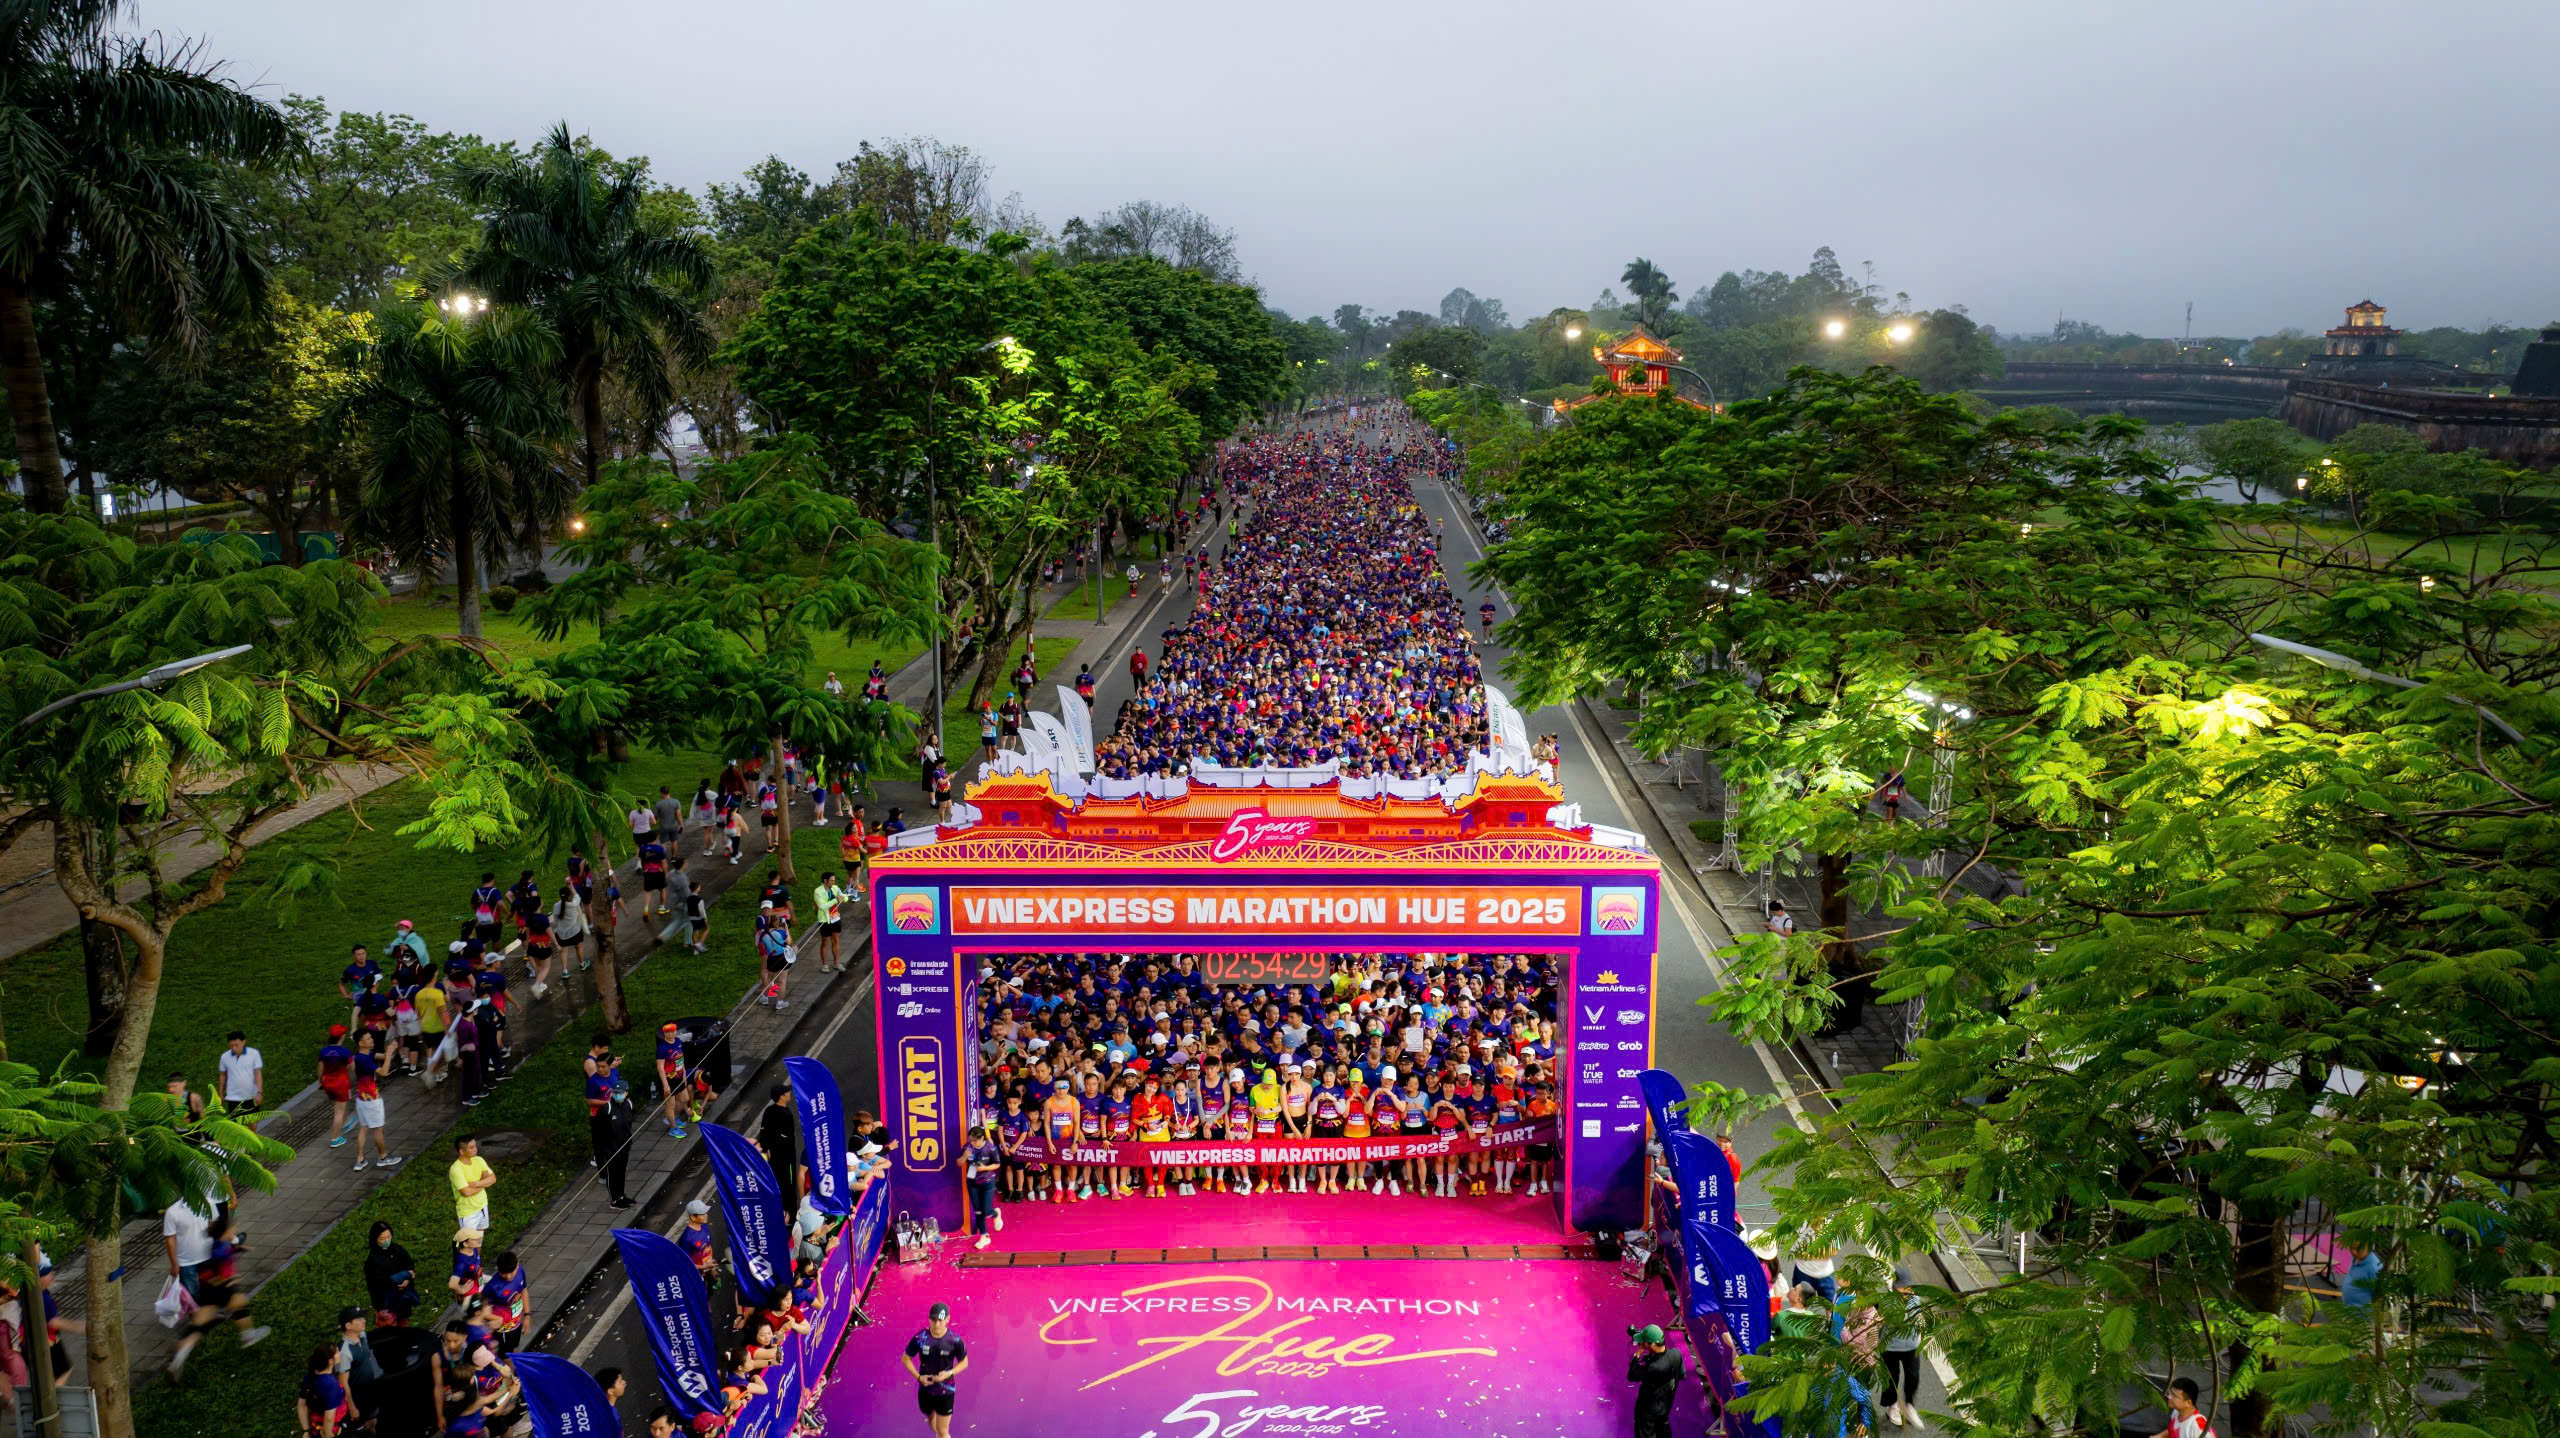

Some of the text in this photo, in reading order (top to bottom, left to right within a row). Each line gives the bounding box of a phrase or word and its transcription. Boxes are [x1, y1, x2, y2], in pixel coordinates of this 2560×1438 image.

[1214, 813, 1310, 858] 5 years
[963, 898, 1566, 924] VNEXPRESS MARATHON HUE 2025
[1206, 952, 1327, 979] 02:54:29
[897, 1001, 923, 1018] FPT
[1617, 1041, 1643, 1051] Grab
[1583, 1071, 1603, 1079] true
[905, 1047, 939, 1161] START
[817, 1091, 832, 1170] Marathon 2025
[1020, 1145, 1043, 1153] Express
[1061, 1126, 1536, 1164] START VNEXPRESS MARATHON HUE 2025 START
[1698, 1180, 1706, 1199] Hue
[1709, 1175, 1718, 1197] 2025
[736, 1175, 757, 1255] VnExpress Hue
[746, 1171, 769, 1255] Marathon 2025
[1724, 1279, 1733, 1299] Hue
[1736, 1274, 1748, 1299] 2025
[1048, 1297, 1480, 1315] VNEXPRESS MARATHON
[657, 1282, 686, 1372] VnExpress Hue
[668, 1275, 700, 1367] Marathon 2025
[1255, 1361, 1337, 1379] 2025
[561, 1412, 574, 1435] Hue
[574, 1404, 591, 1432] 2025
[1139, 1389, 1387, 1438] 5 years
[1263, 1424, 1346, 1434] 2020-2025
